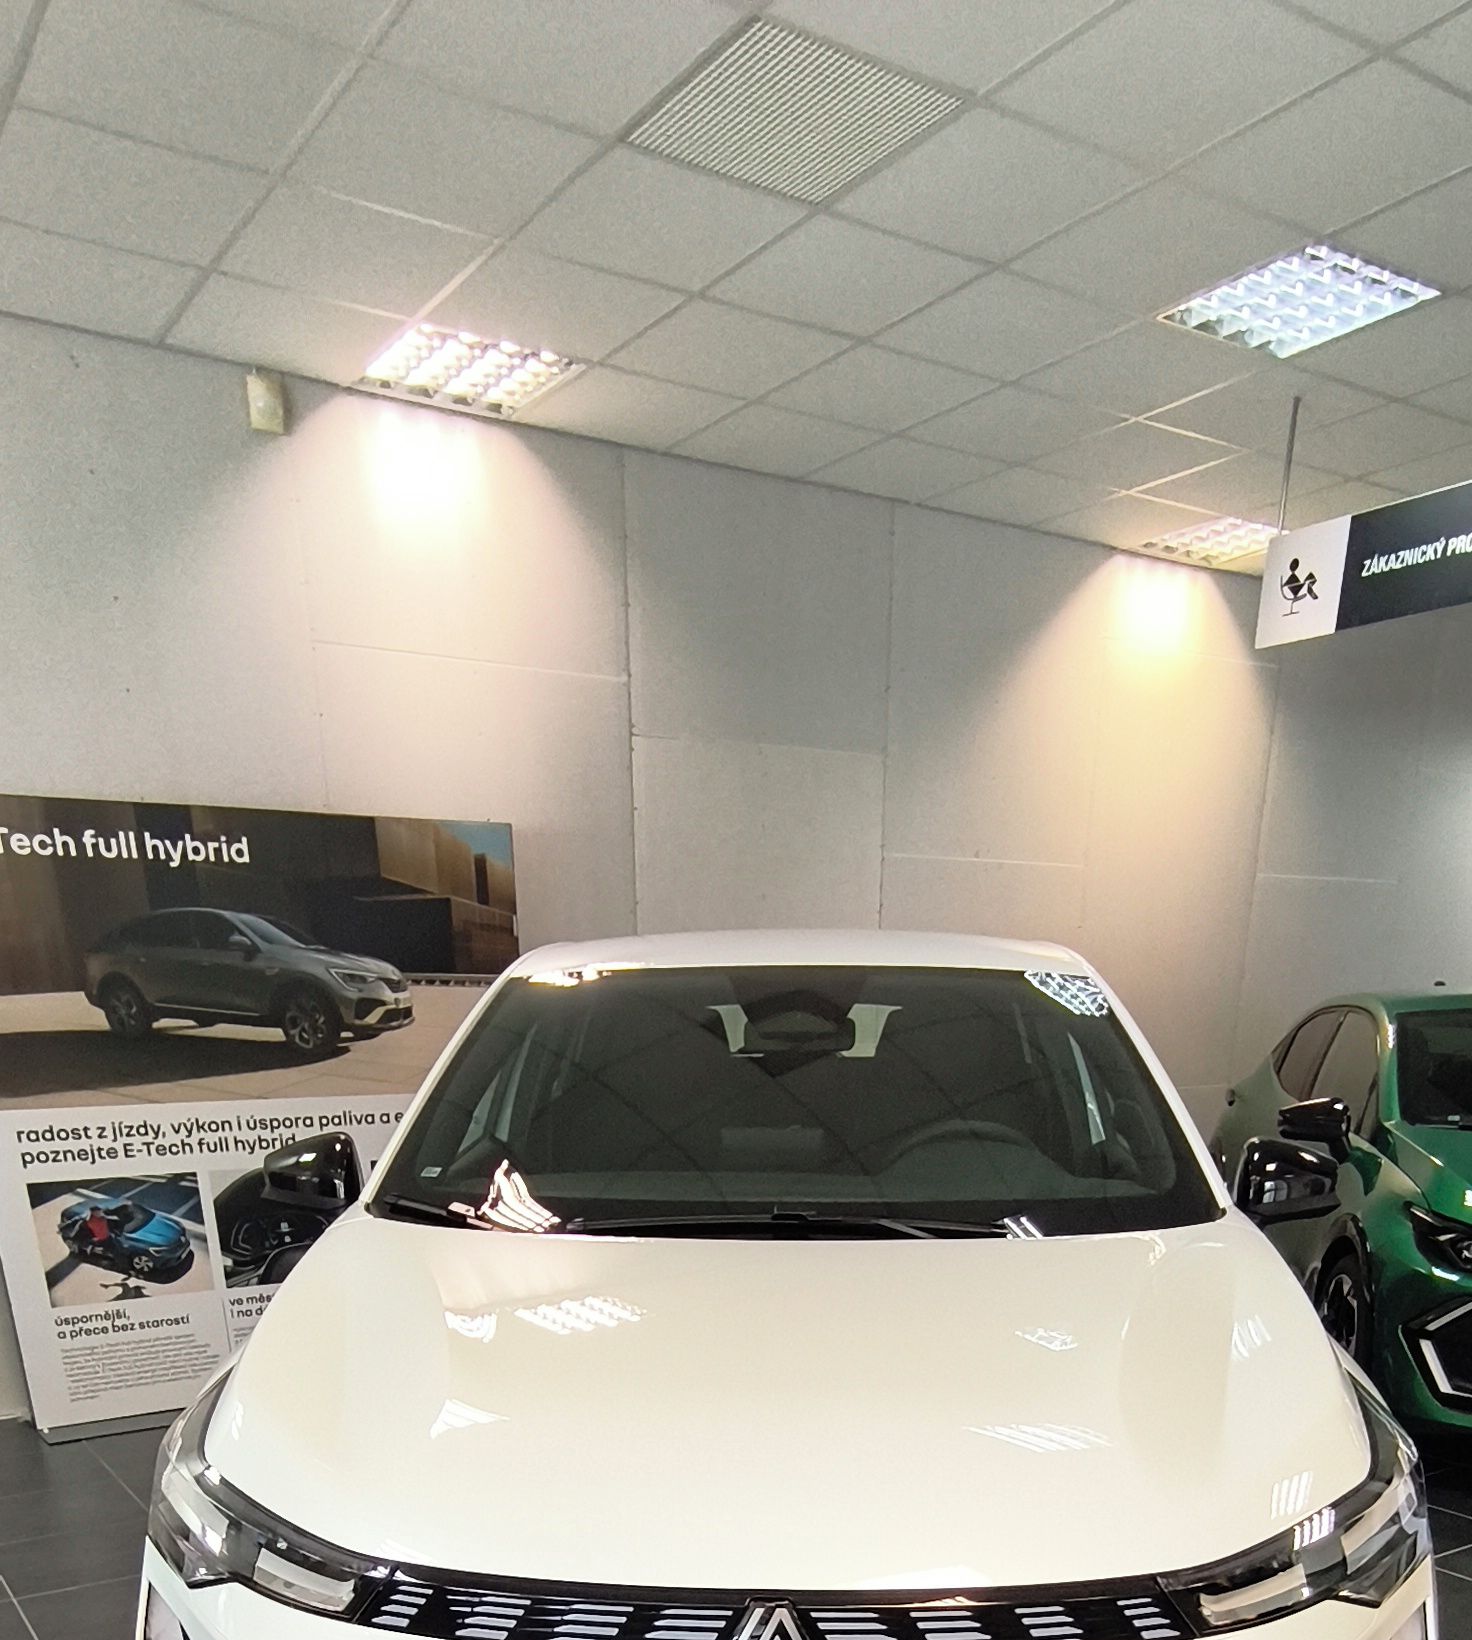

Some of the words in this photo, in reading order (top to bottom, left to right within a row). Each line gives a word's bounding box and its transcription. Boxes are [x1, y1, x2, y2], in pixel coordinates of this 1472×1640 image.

[1361, 536, 1447, 577] ZÁKAZNICKÝ
[82, 829, 139, 860] full
[144, 831, 250, 868] hybrid
[16, 1125, 93, 1144] radost
[96, 1126, 108, 1140] z
[111, 1119, 167, 1143] jízdy,
[170, 1117, 233, 1139] výkon
[236, 1115, 242, 1132] i
[245, 1114, 314, 1134] úspora
[318, 1109, 375, 1132] paliva
[379, 1112, 390, 1125] a
[20, 1143, 119, 1170] poznejte
[122, 1138, 194, 1159] E-Tech
[197, 1136, 229, 1154] full
[233, 1132, 296, 1155] hybrid
[57, 1330, 67, 1340] a
[69, 1325, 110, 1341] přece
[111, 1321, 137, 1334] bez
